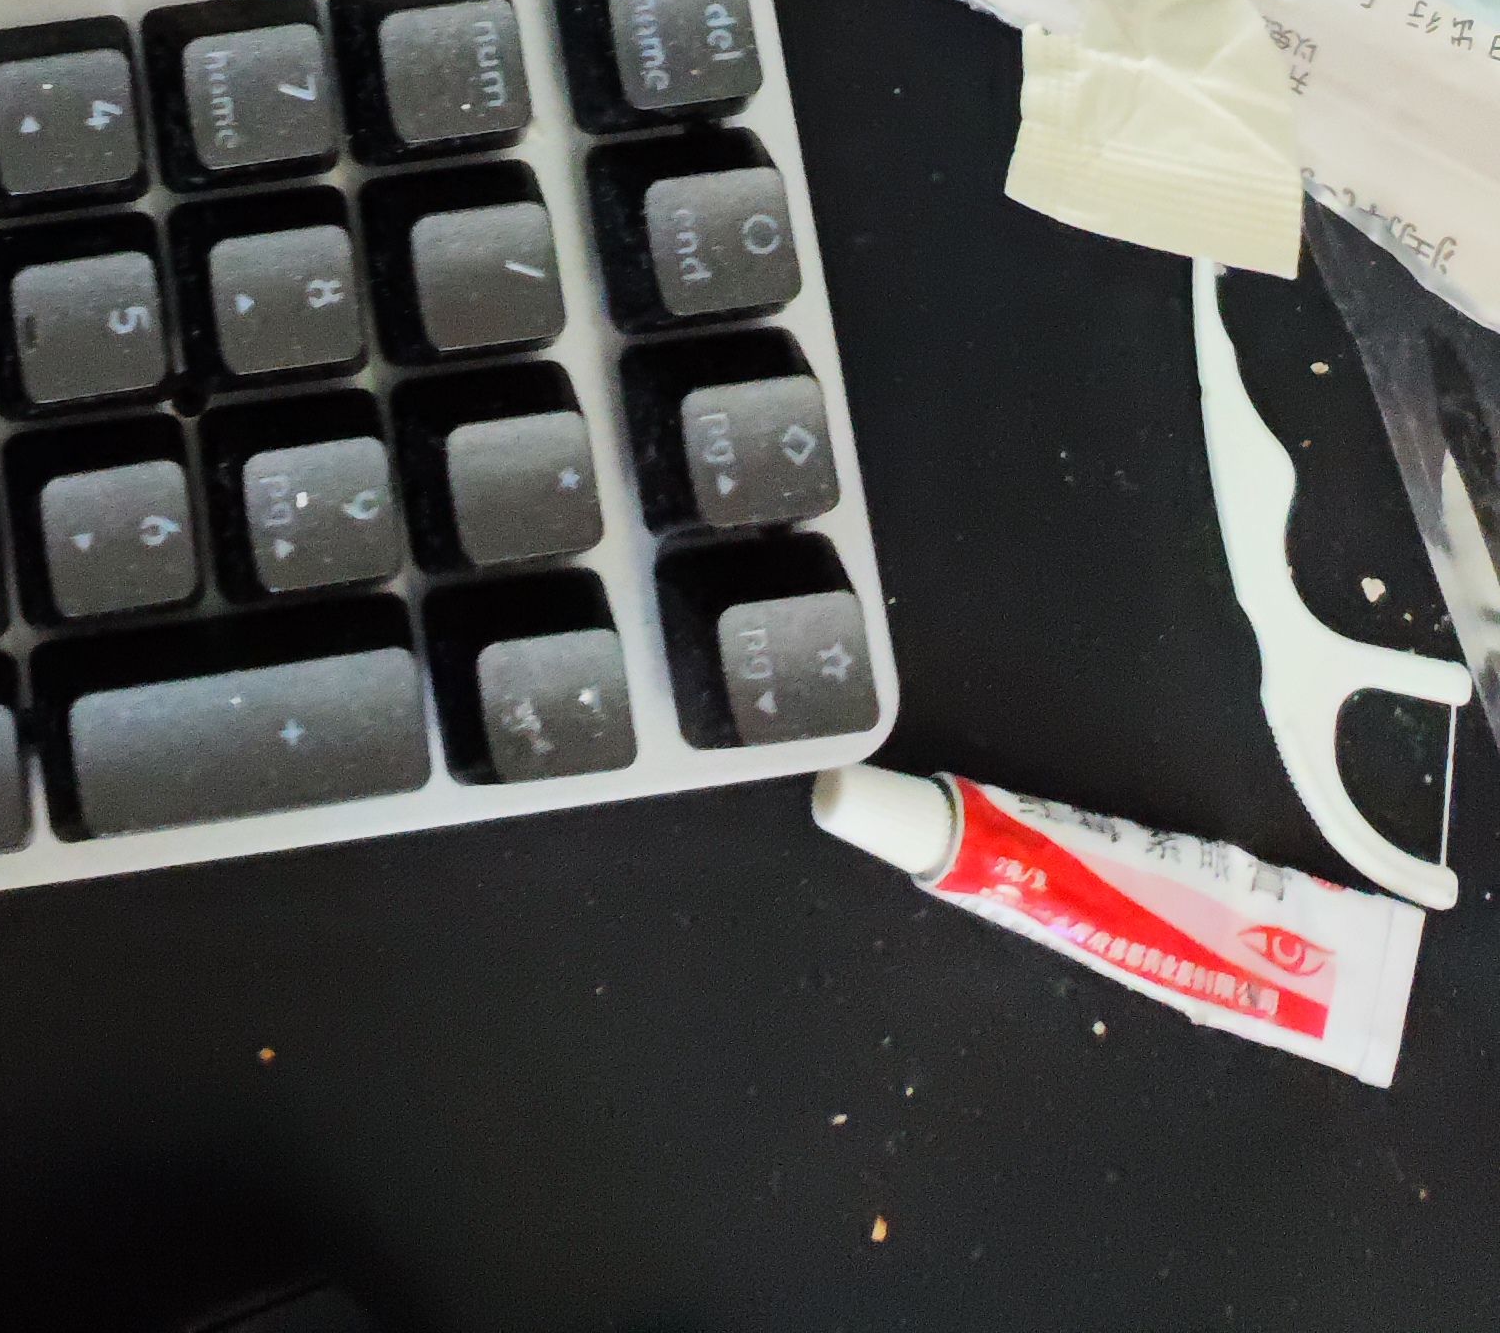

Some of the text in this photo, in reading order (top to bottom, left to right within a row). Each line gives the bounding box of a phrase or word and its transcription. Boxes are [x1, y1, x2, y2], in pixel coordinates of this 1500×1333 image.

[702, 2, 746, 62] del
[471, 19, 507, 108] num
[203, 50, 240, 149] home
[277, 75, 317, 101] 7
[84, 99, 125, 131] 4
[674, 207, 713, 282] end
[106, 305, 149, 335] 5
[343, 490, 383, 521] 9
[137, 515, 181, 547] 6
